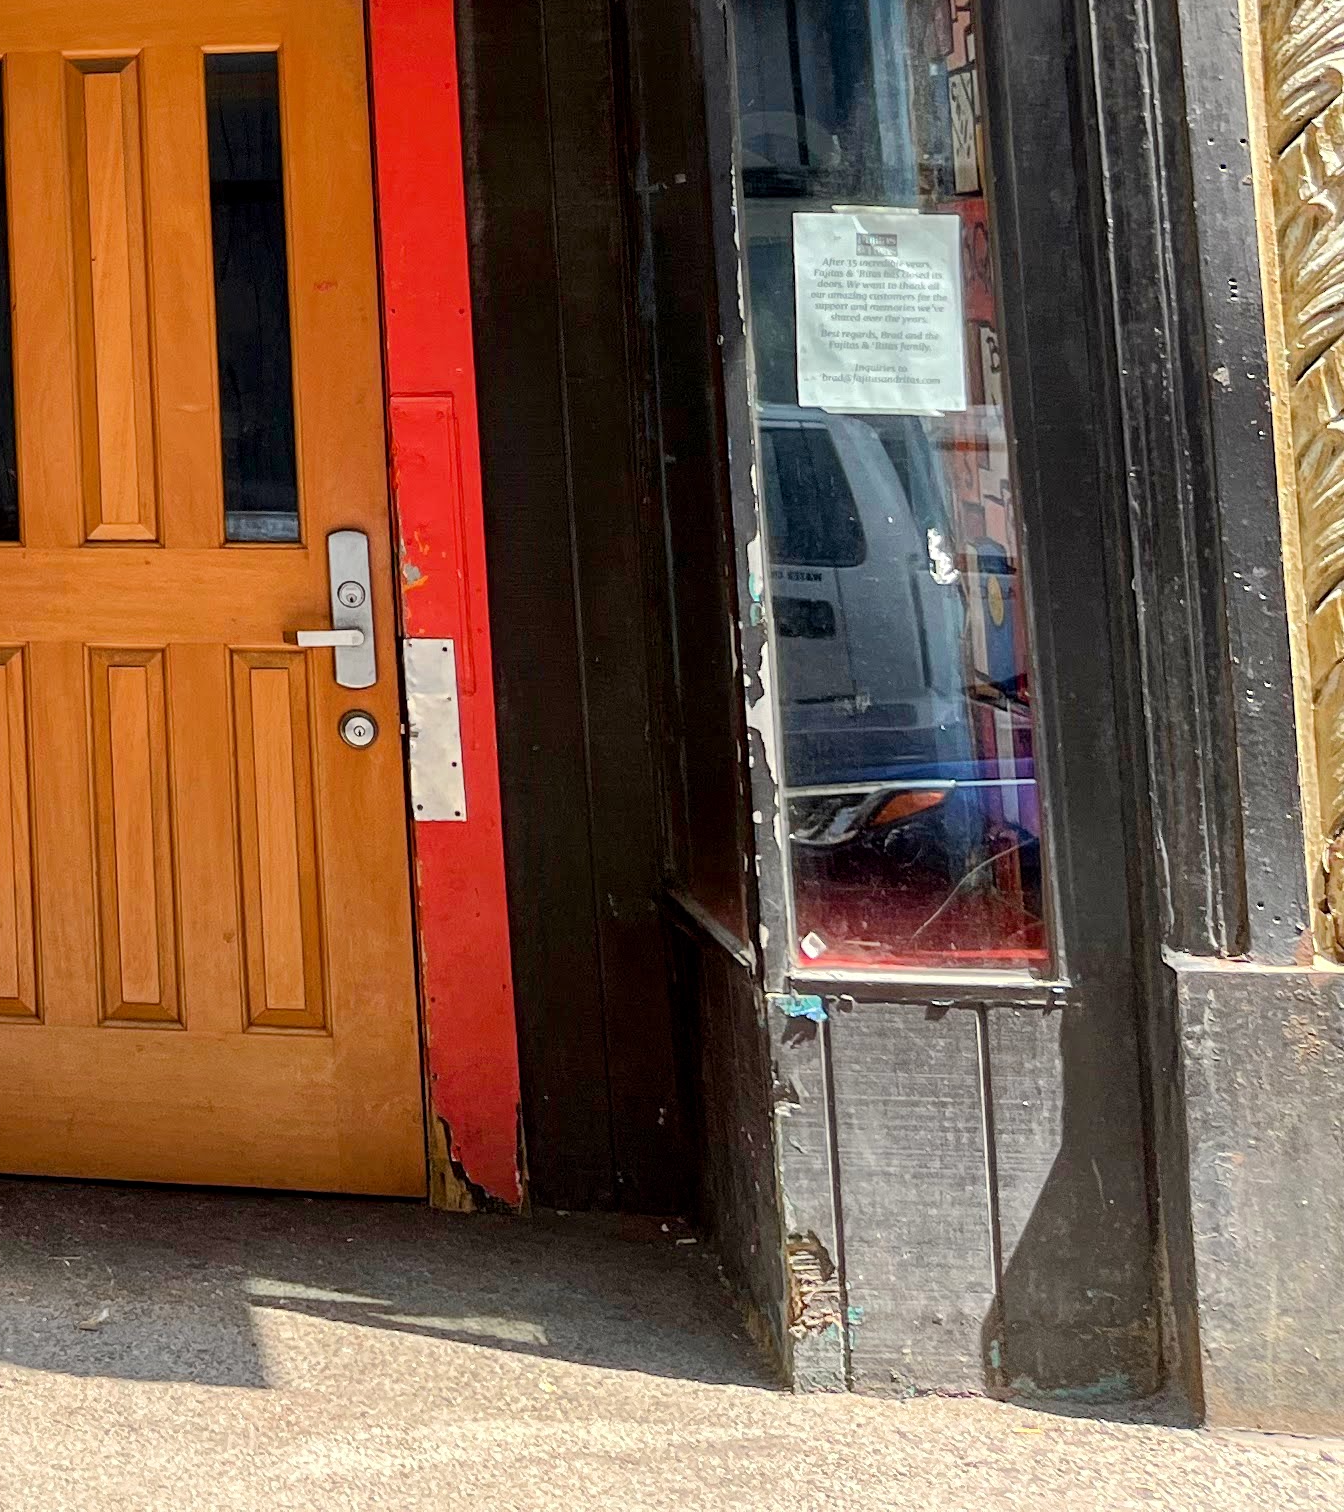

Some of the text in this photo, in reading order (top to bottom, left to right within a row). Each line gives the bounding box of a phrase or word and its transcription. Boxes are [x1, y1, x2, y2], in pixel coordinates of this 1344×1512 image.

[828, 292, 867, 301] amazing
[869, 292, 915, 301] customers
[932, 293, 948, 301] the
[815, 302, 848, 311] support
[850, 303, 867, 311] and
[869, 304, 915, 312] memories
[831, 313, 861, 321] shared
[885, 314, 900, 322] the
[821, 329, 840, 337] Best
[905, 331, 923, 340] and
[925, 331, 940, 340] the
[829, 341, 859, 350] Fajitas
